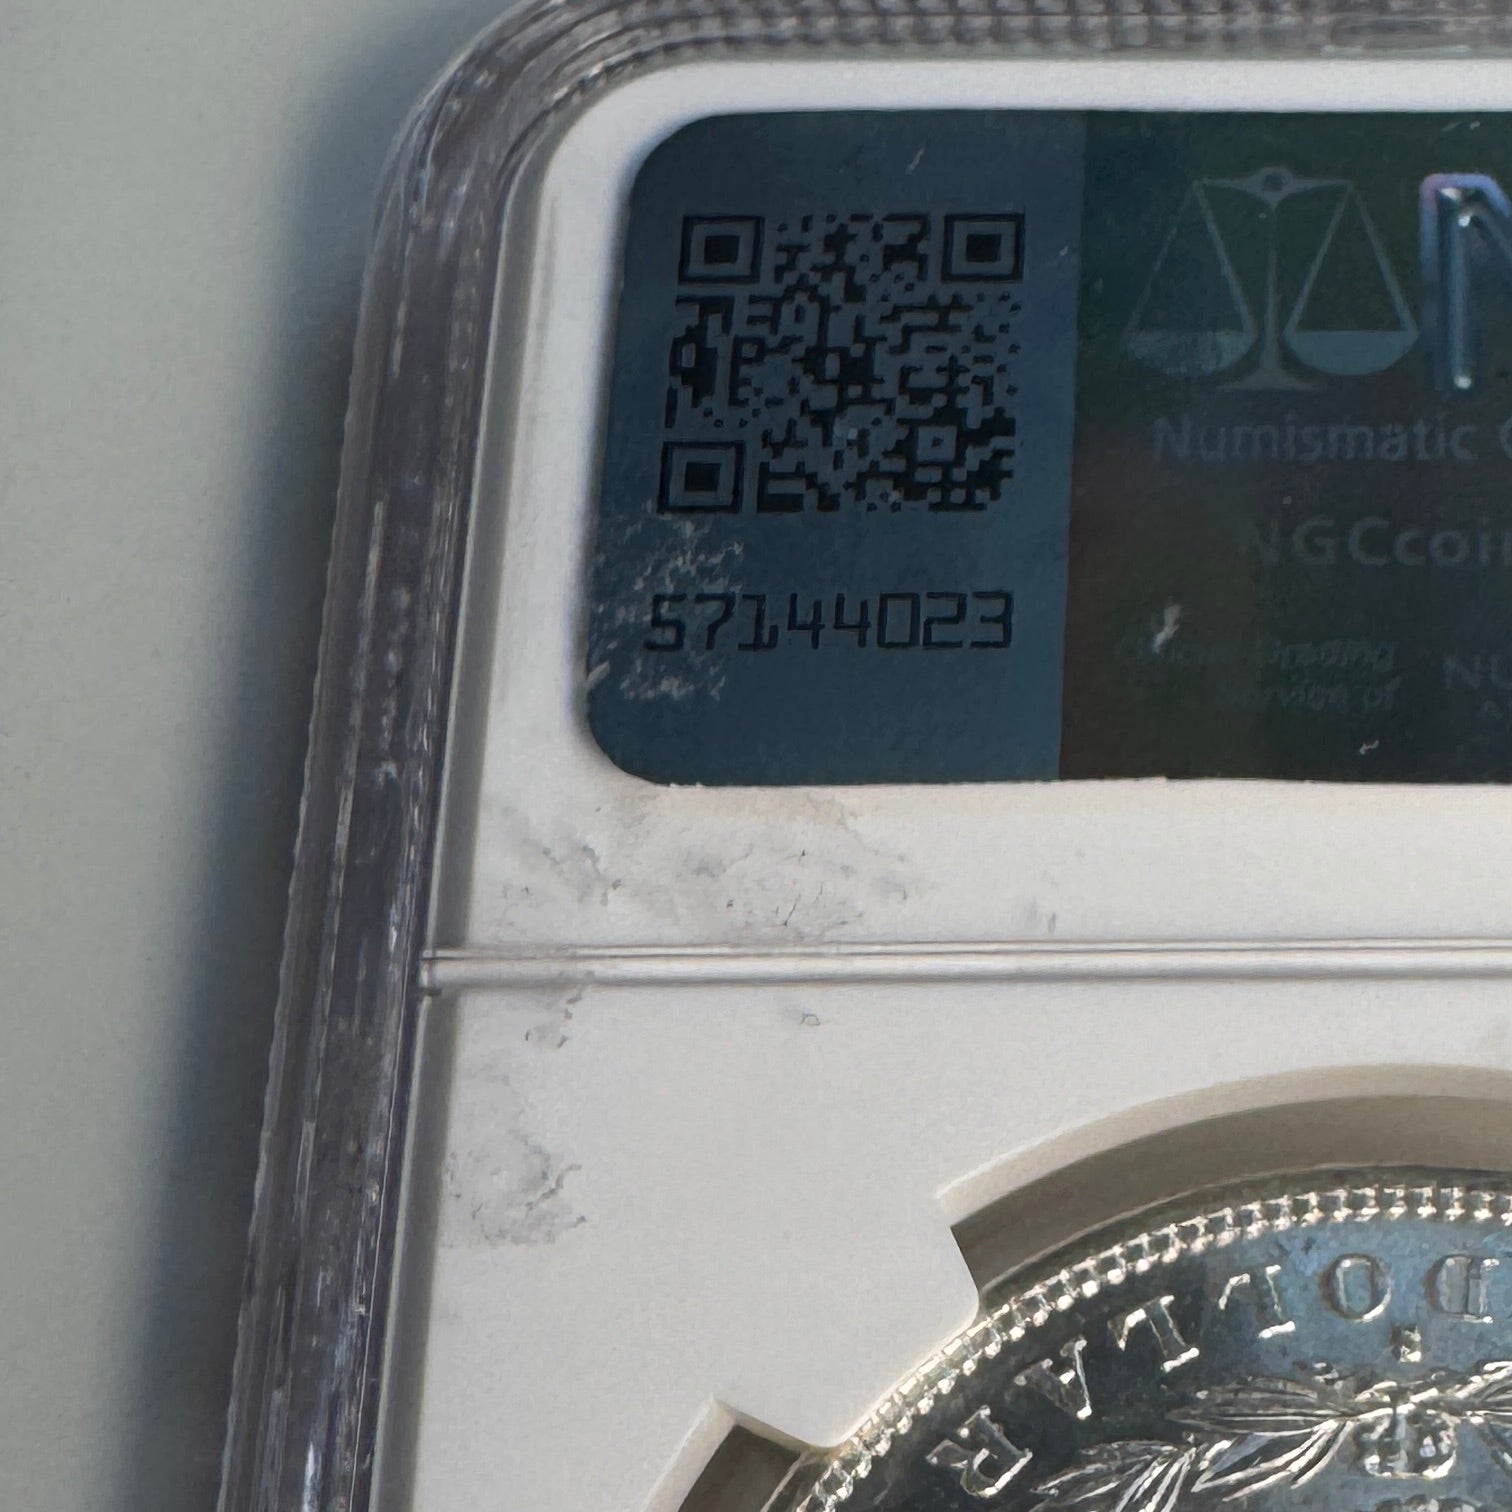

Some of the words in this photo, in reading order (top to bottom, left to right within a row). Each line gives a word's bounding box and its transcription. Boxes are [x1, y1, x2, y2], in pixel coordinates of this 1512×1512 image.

[1152, 410, 1478, 464] Numismatic
[645, 590, 1016, 652] 57144023
[923, 1250, 1500, 1499] DOLLAR
